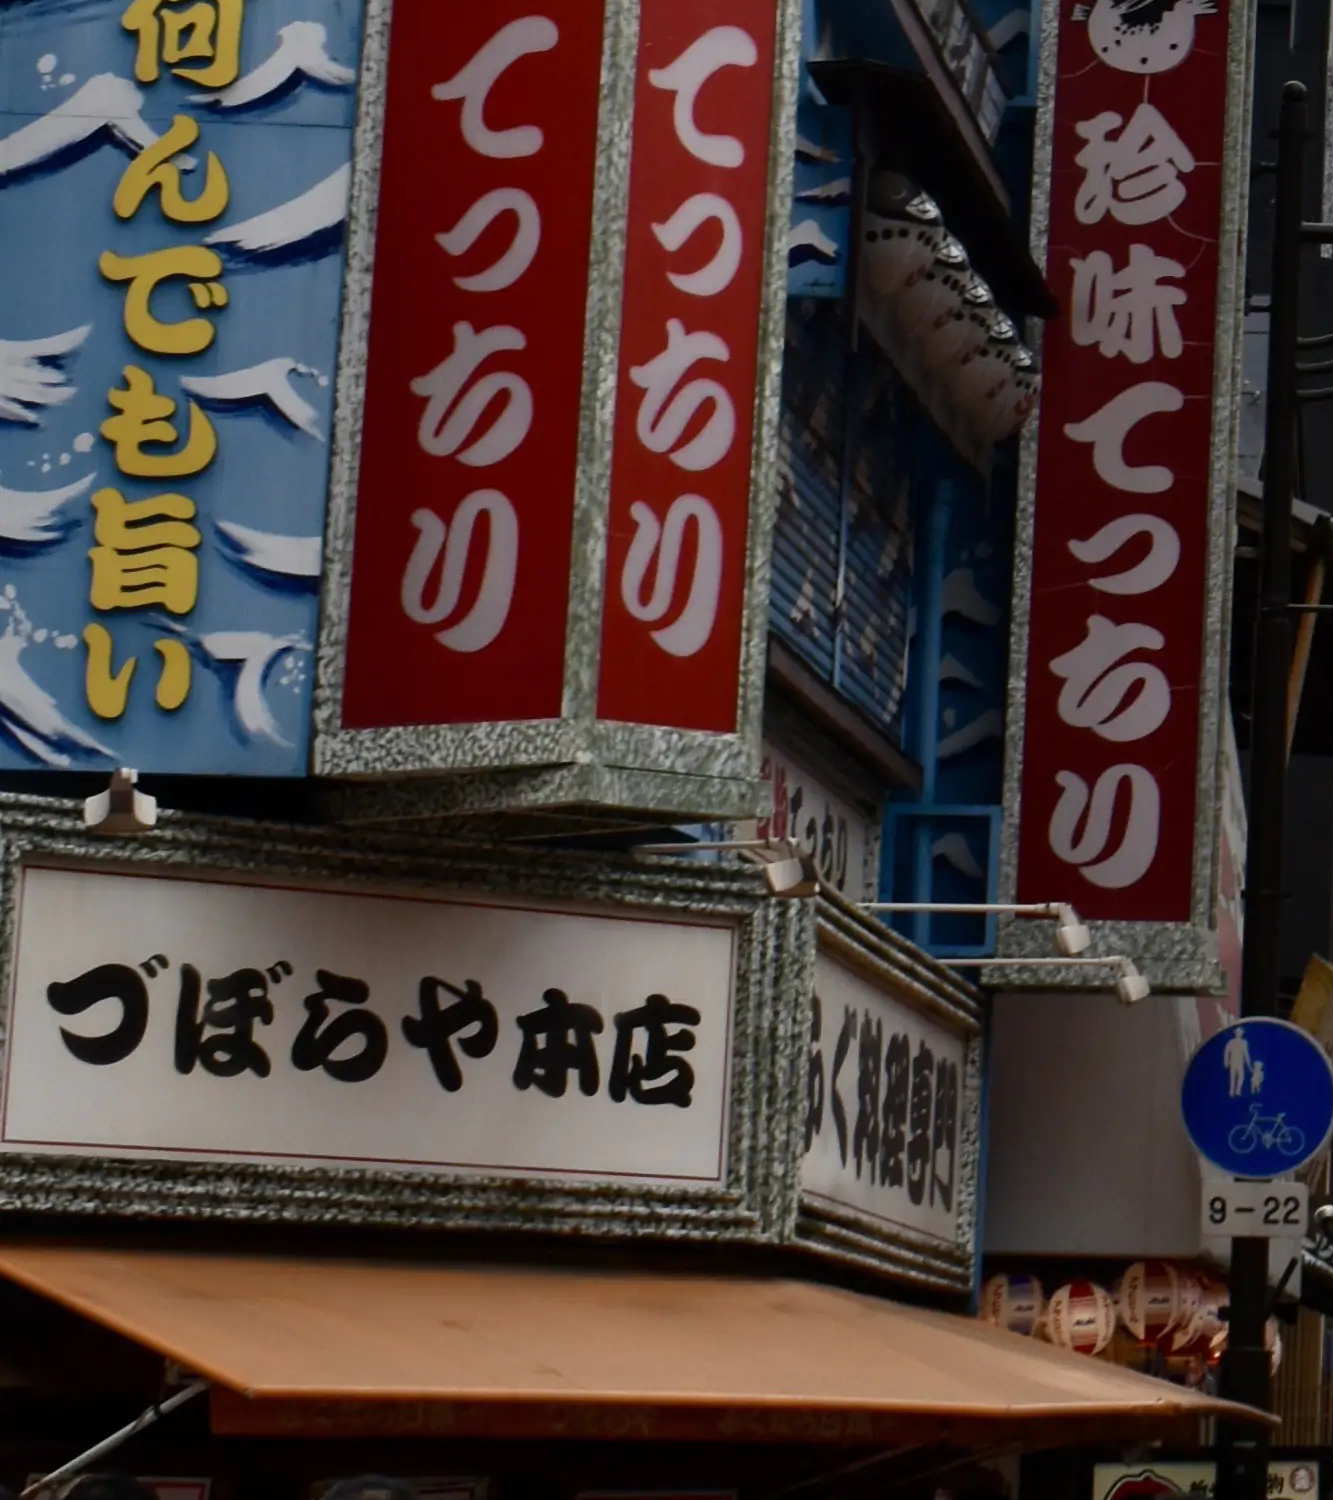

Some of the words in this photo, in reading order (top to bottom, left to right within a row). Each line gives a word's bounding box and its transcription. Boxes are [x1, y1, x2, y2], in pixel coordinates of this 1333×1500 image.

[45, 953, 701, 1109] づぼらや本店
